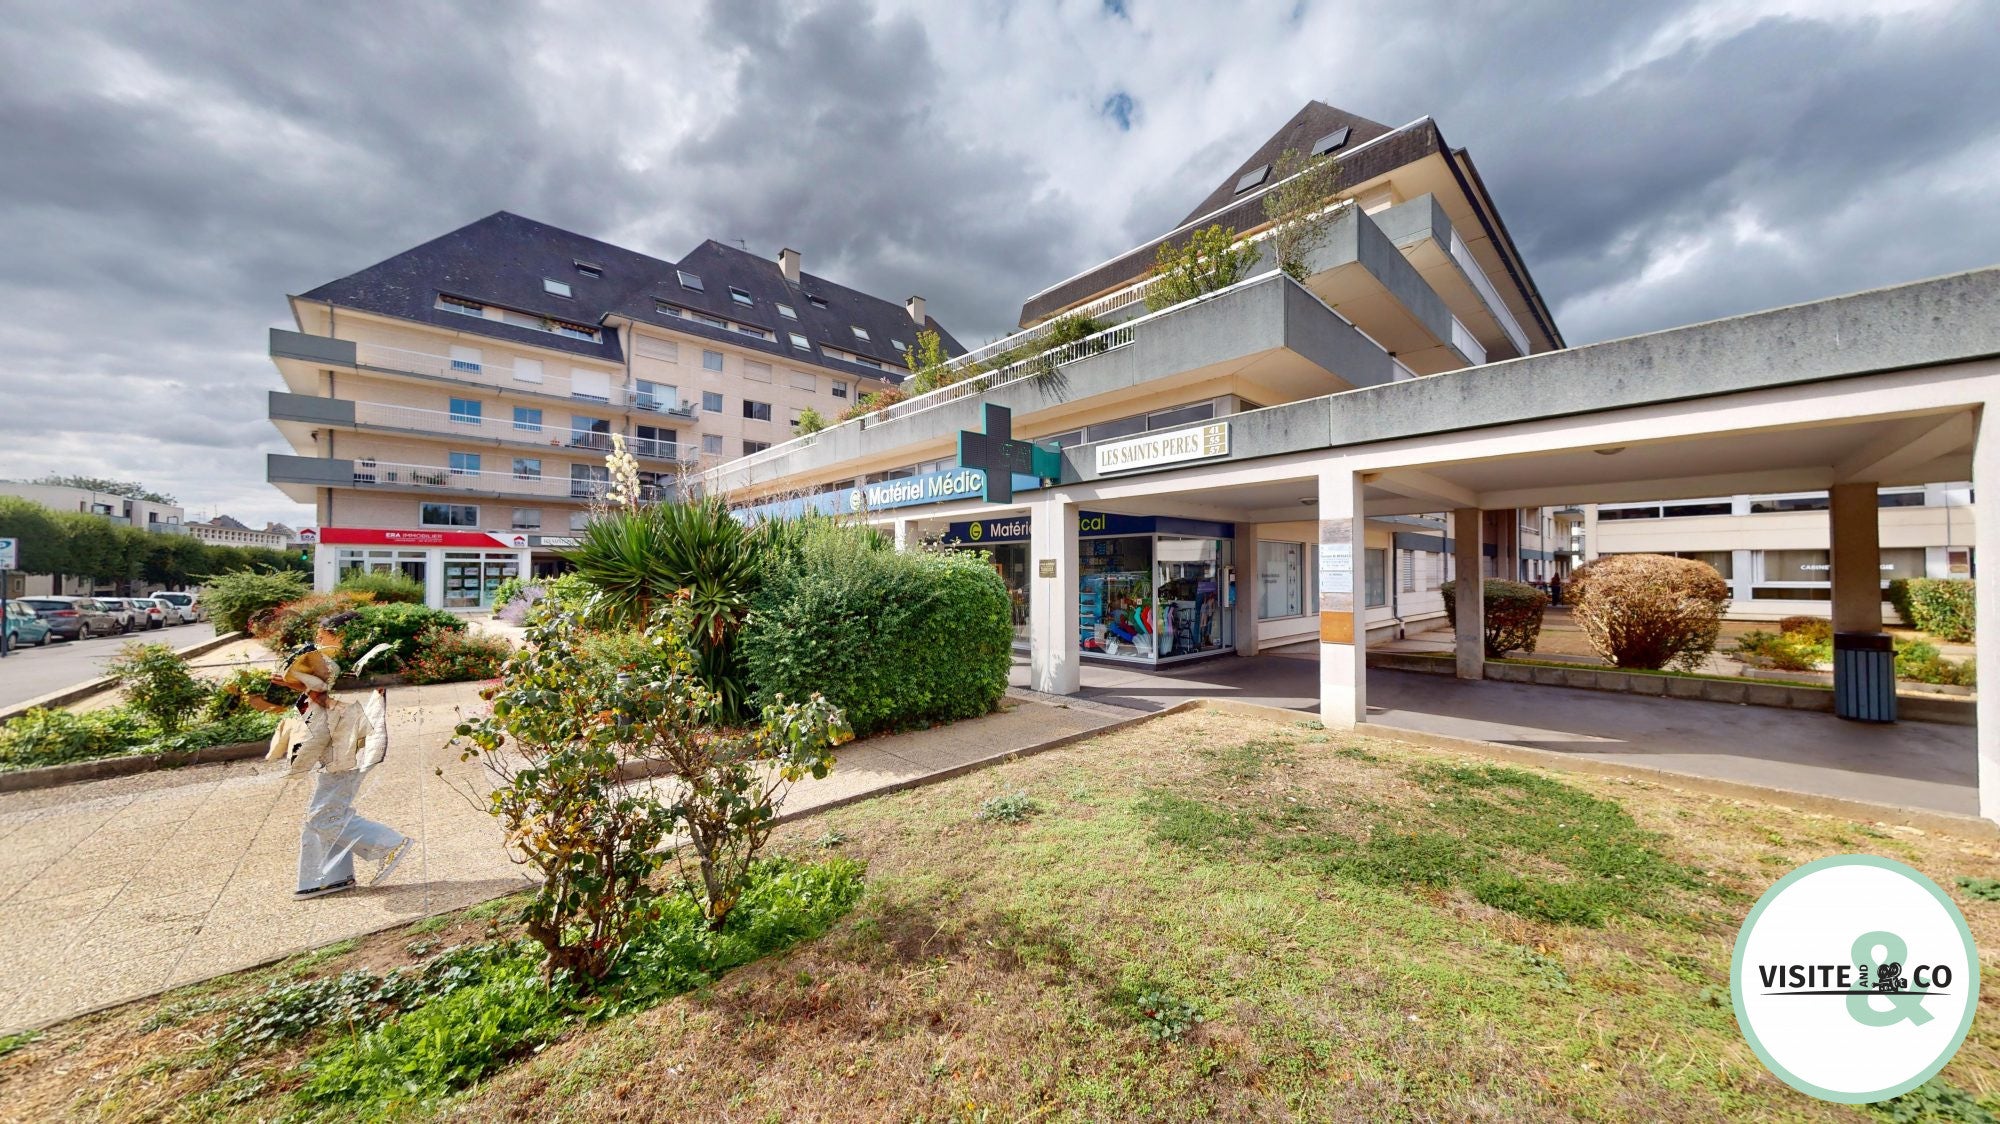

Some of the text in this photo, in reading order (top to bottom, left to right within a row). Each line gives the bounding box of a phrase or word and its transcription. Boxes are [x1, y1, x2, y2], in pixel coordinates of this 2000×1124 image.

[1209, 426, 1219, 435] 41
[1209, 435, 1220, 445] 55
[1101, 433, 1199, 467] LES SAINTS PERES
[868, 479, 924, 506] Matériel
[928, 471, 984, 498] Médic
